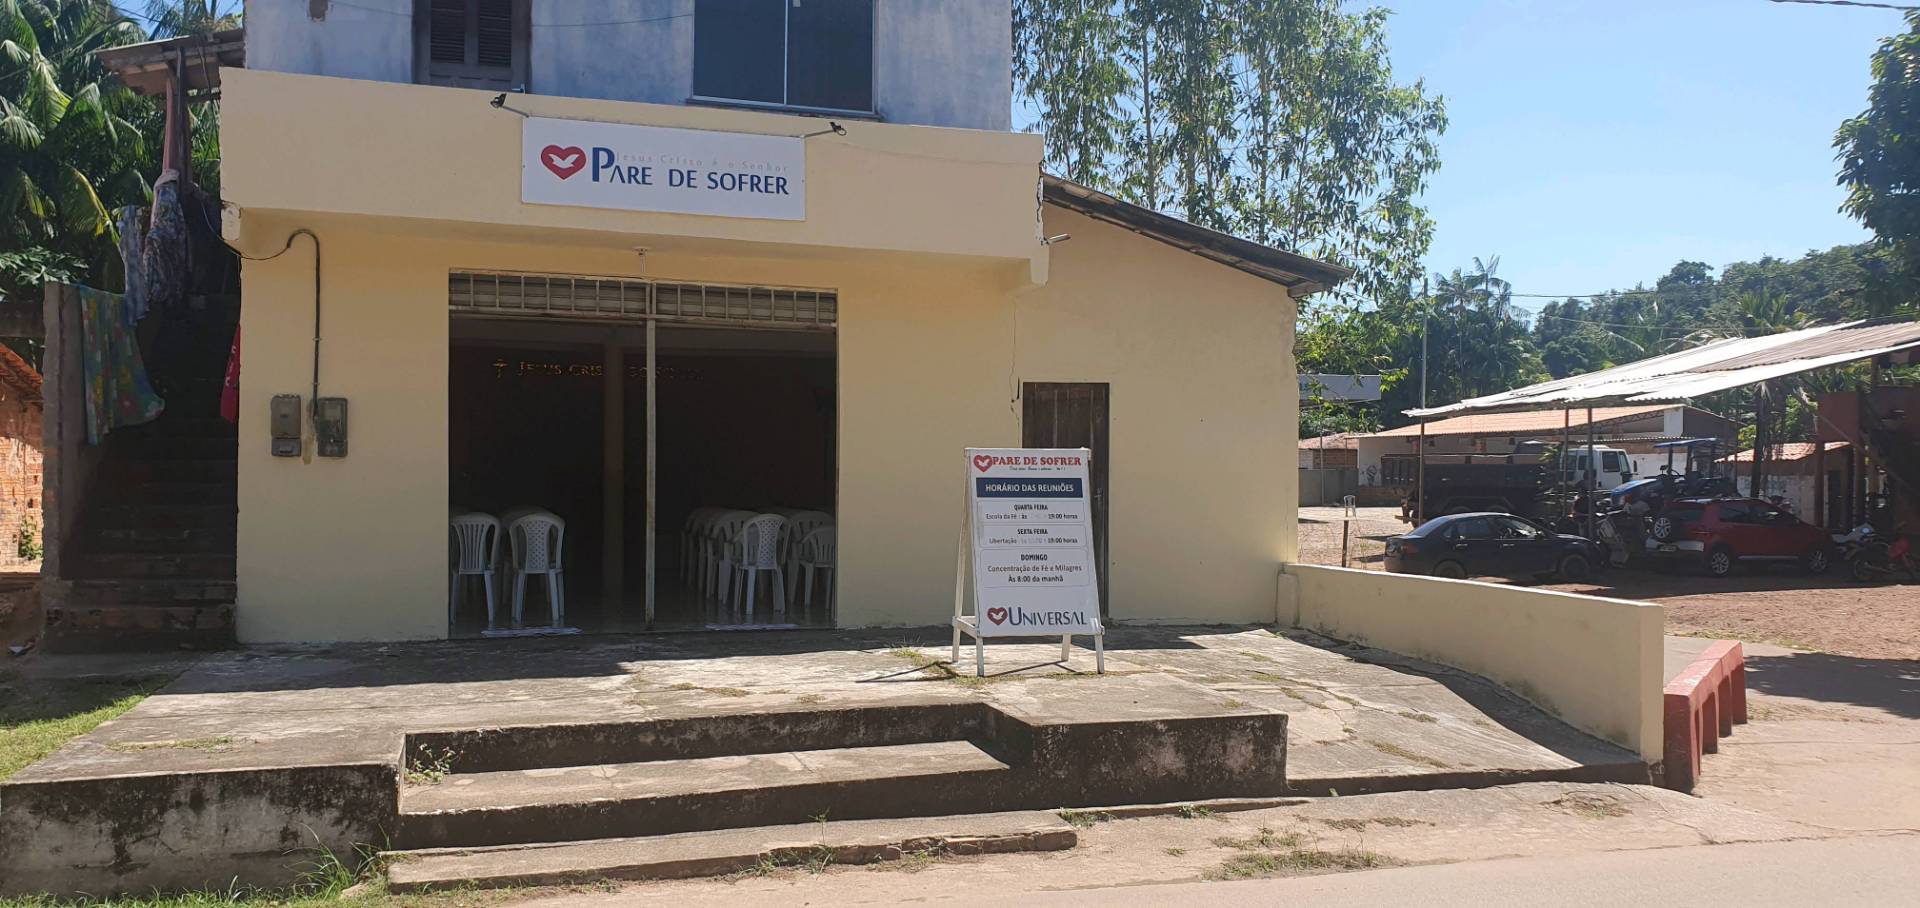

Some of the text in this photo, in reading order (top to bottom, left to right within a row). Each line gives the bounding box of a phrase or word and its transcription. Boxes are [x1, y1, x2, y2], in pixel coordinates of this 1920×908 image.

[668, 168, 698, 188] DE
[707, 171, 790, 195] SOFRER
[992, 457, 1082, 466] PARE DE SOFRER
[985, 483, 1020, 492] HORÁRIO
[1038, 483, 1074, 492] REUNIÕES
[988, 565, 1031, 573] Concentração
[1055, 565, 1082, 573] Milagres
[1008, 607, 1088, 626] UNIVERSAL
